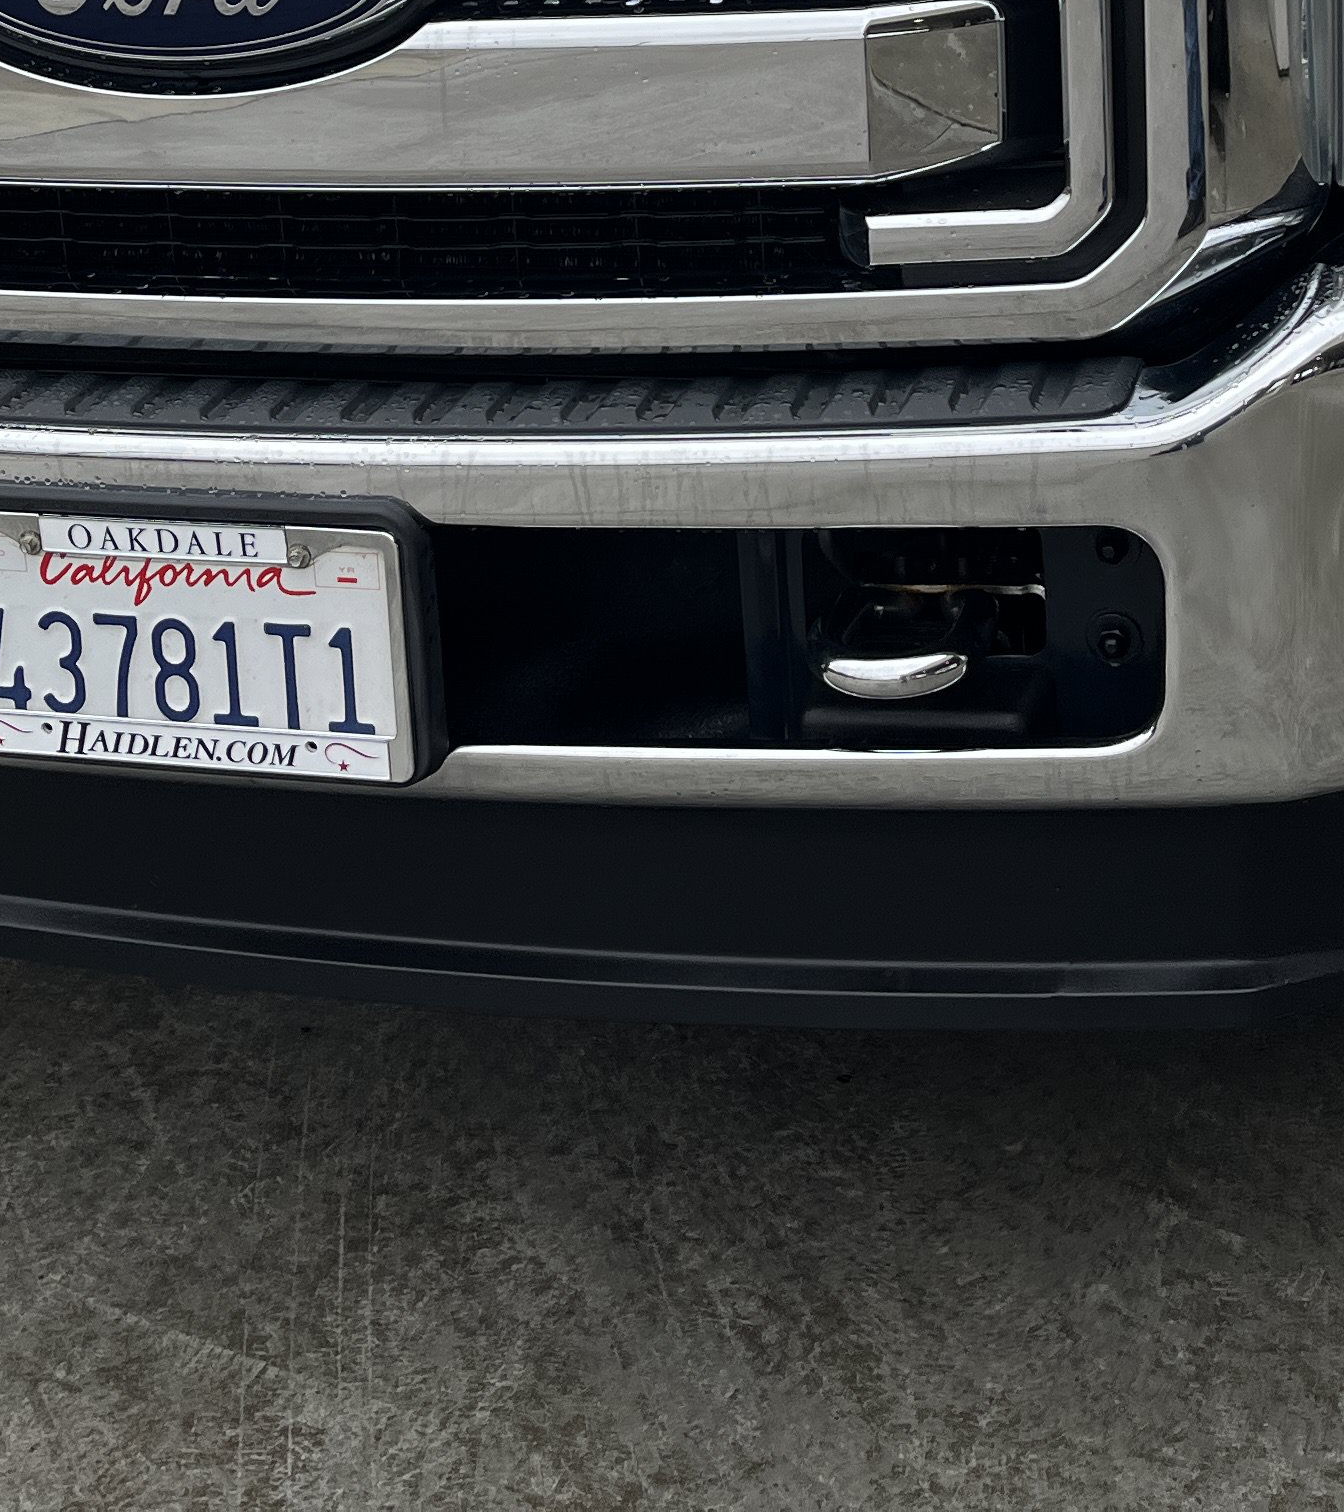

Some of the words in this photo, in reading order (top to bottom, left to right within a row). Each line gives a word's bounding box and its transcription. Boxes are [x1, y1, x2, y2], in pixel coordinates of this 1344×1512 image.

[67, 522, 260, 558] OAKDALE
[40, 551, 316, 606] California
[56, 720, 301, 768] HAIDLEN.COM
